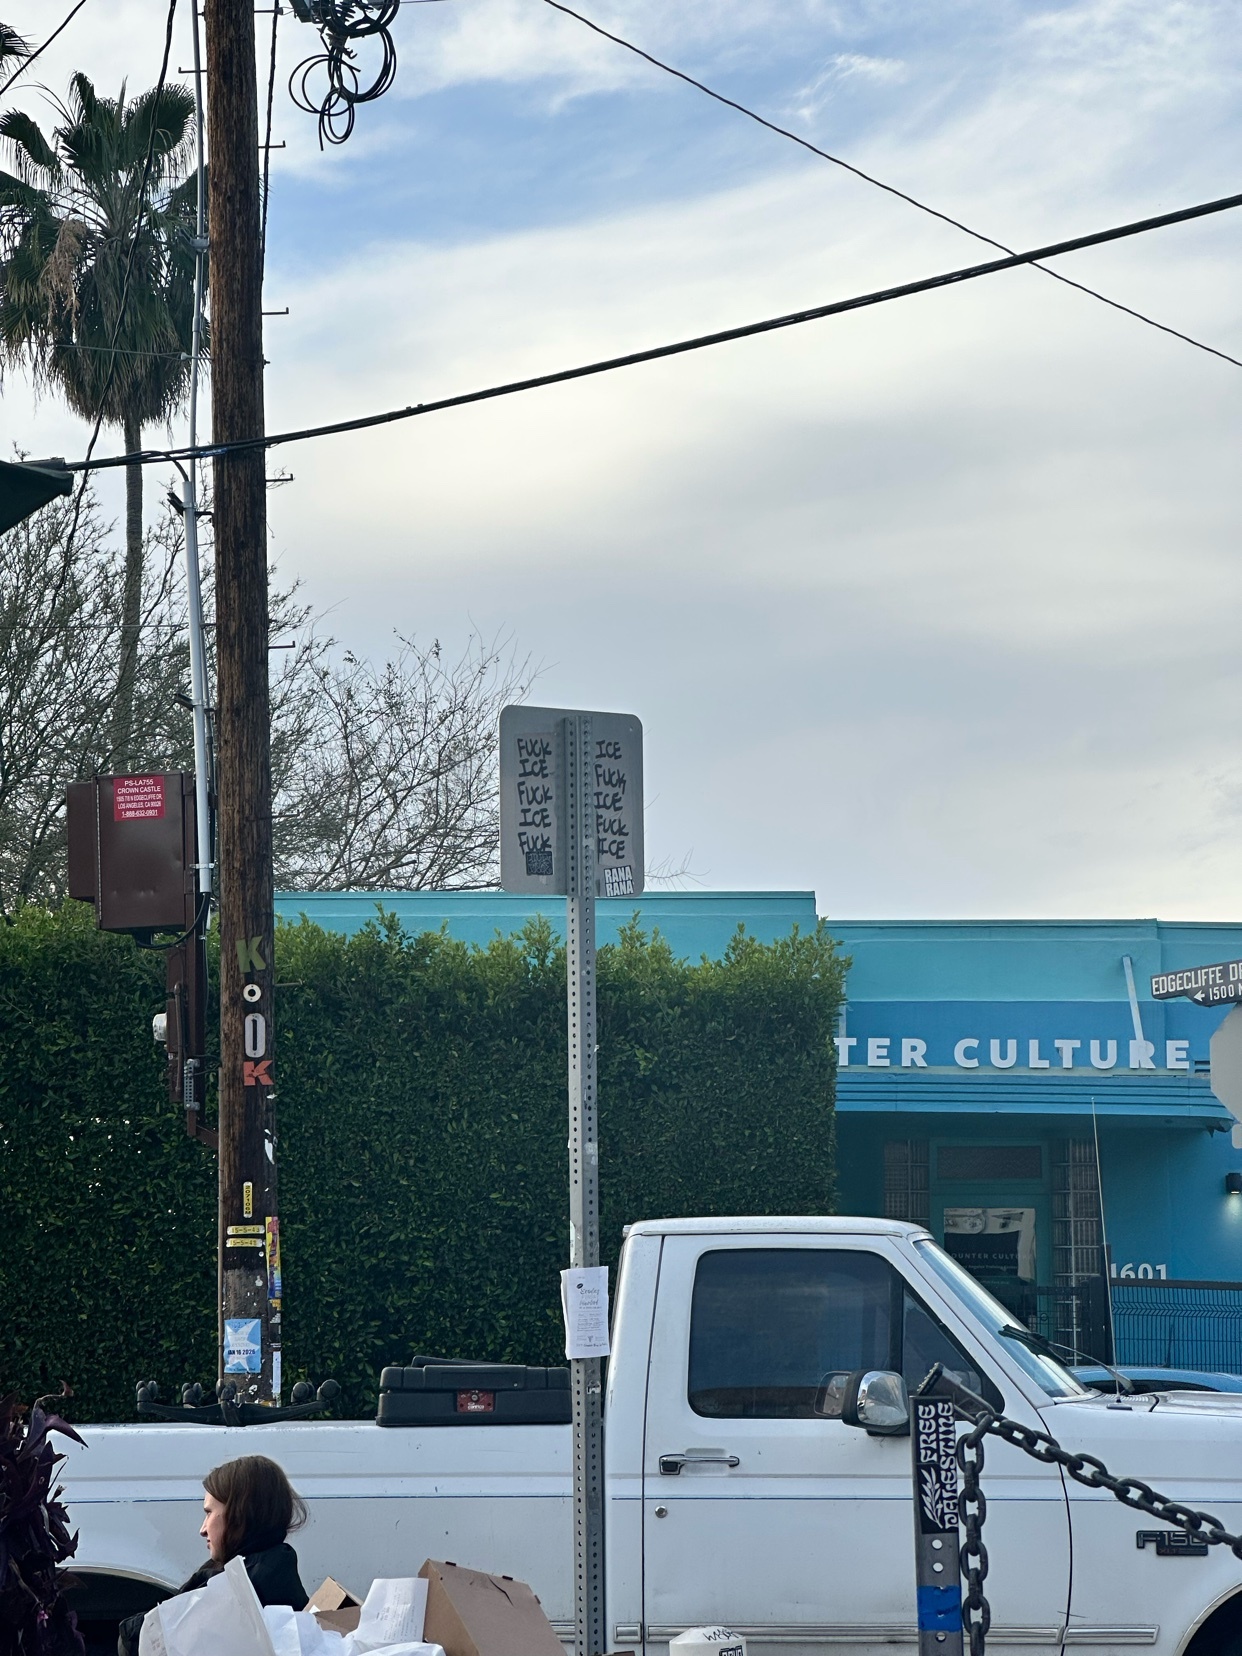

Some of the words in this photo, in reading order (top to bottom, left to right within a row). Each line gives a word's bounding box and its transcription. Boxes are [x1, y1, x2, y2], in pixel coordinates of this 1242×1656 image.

[517, 738, 552, 758] FUCK
[595, 740, 622, 759] ICE
[519, 759, 549, 778] ICE
[124, 779, 154, 787] PS-LA755
[594, 764, 626, 794] FUCK
[517, 781, 552, 805] FUCK
[594, 792, 623, 811] ICE
[519, 808, 551, 828] ICE
[596, 815, 629, 836] FUCK
[517, 832, 551, 855] FUCK
[598, 838, 625, 859] ICE
[604, 866, 632, 883] RANA
[605, 882, 634, 897] RANA
[1152, 966, 1223, 995] EDGECLIFFE
[1209, 984, 1235, 1000] 1500
[954, 1039, 1190, 1068] CULTURE
[918, 1404, 938, 1463] FREE
[937, 1402, 959, 1529] PALESTINE
